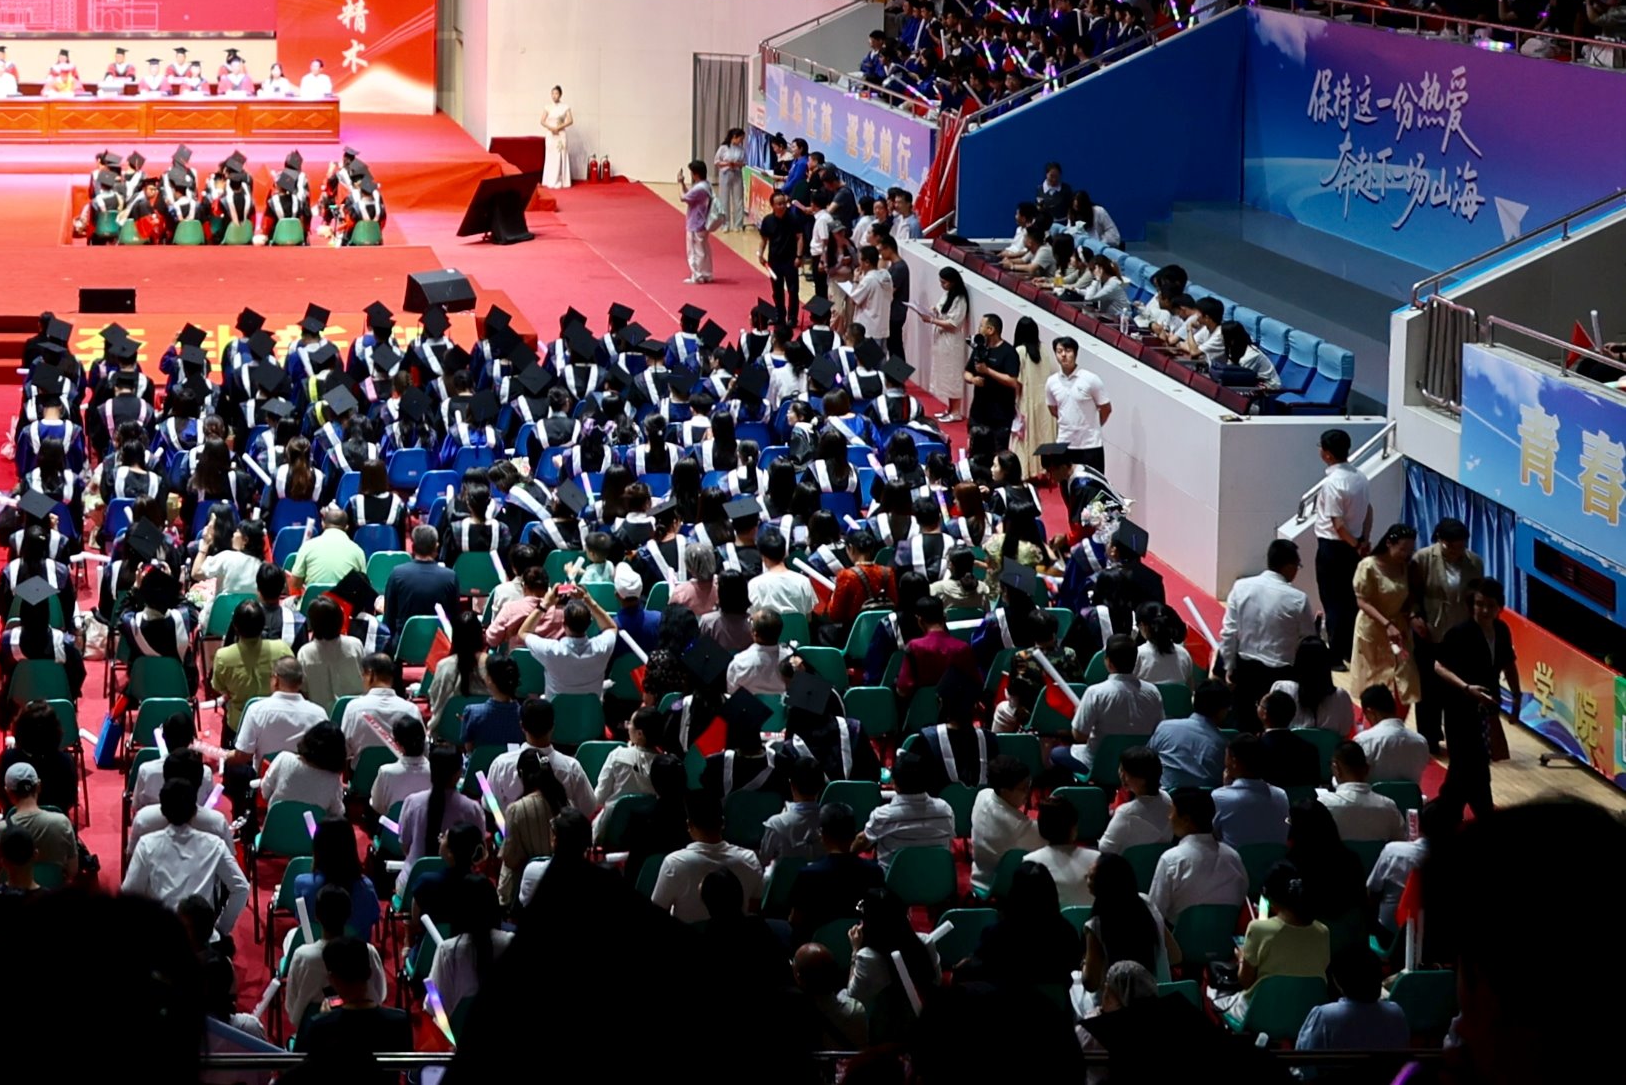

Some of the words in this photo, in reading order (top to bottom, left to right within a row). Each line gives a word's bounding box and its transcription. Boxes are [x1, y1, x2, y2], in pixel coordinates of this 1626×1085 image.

[1306, 65, 1484, 159] 保持这一份热爱
[1320, 130, 1486, 230] 奔赴下一场山海
